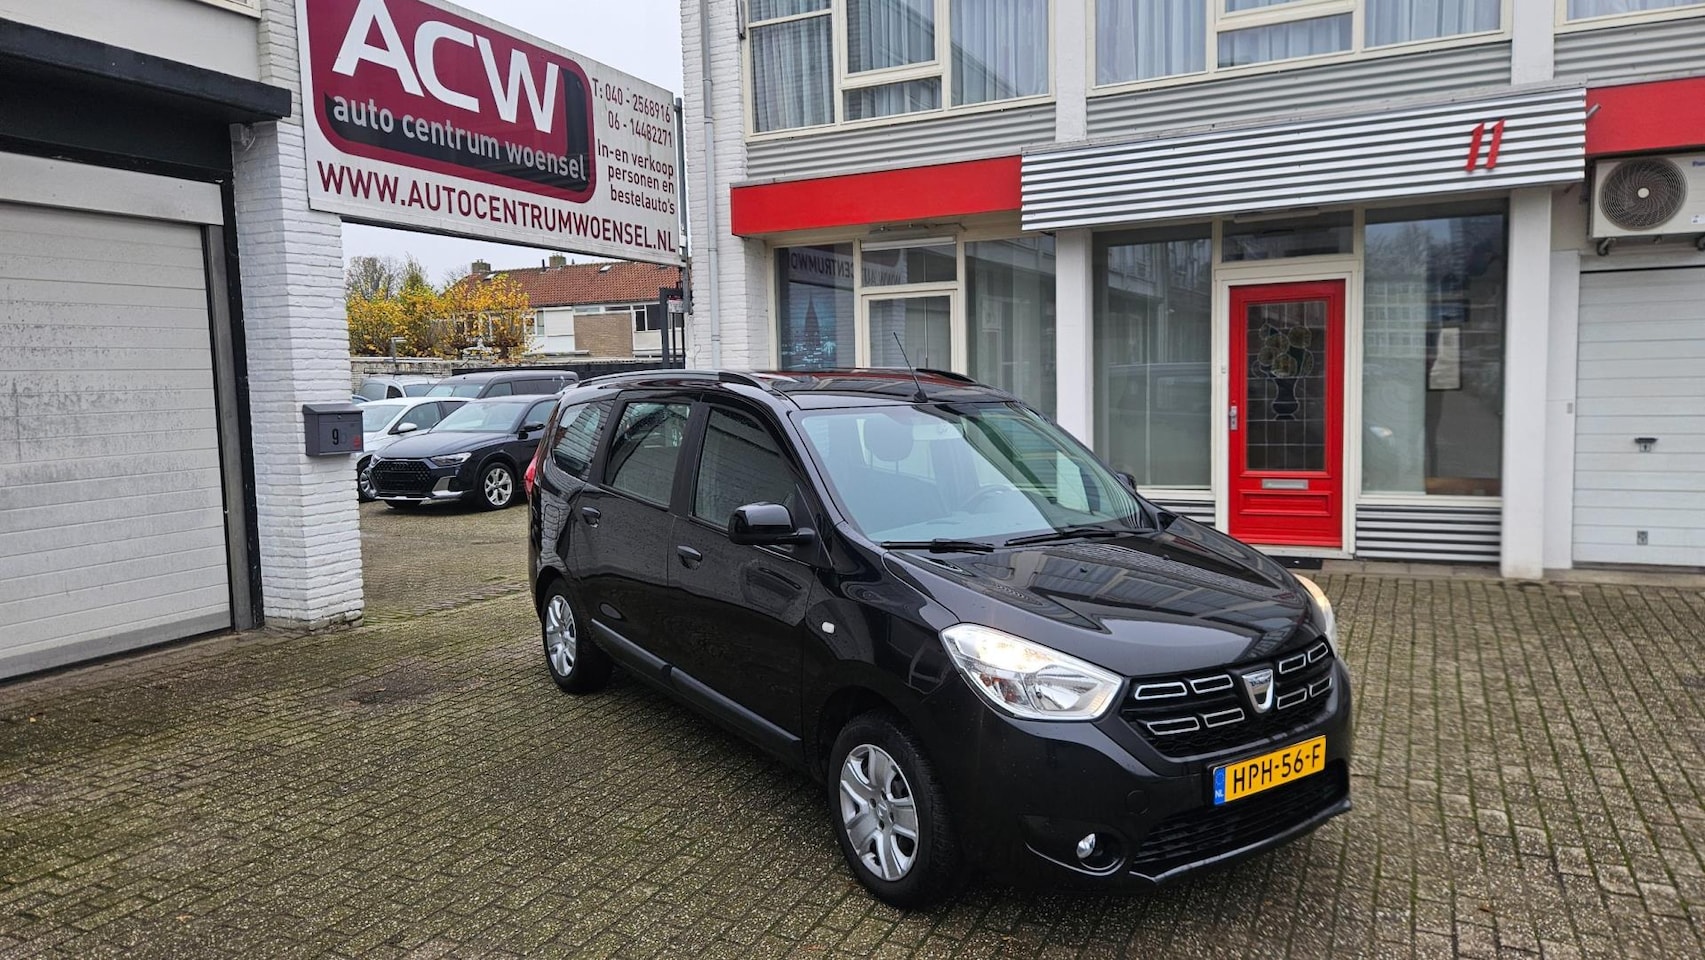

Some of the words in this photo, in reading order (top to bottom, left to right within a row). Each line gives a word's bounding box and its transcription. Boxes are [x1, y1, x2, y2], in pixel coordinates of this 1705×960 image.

[332, 0, 560, 134] ACW
[592, 78, 603, 99] T:
[605, 83, 623, 106] 040
[632, 93, 671, 123] 2568916
[333, 94, 395, 134] auto
[402, 112, 500, 161] centrum
[505, 140, 587, 182] woensel
[608, 110, 620, 130] 06
[630, 117, 673, 148] 14482271
[597, 138, 629, 164] In-en
[631, 151, 674, 179] verkoop
[608, 164, 660, 191] personen
[662, 180, 675, 194] en
[317, 160, 676, 253] WWW.AUTOCENTRUMWOENSEL.NL
[610, 184, 676, 215] bestelauto's
[332, 428, 339, 445] 9
[1233, 743, 1321, 794] HPH-56-F
[1215, 789, 1224, 799] NL
